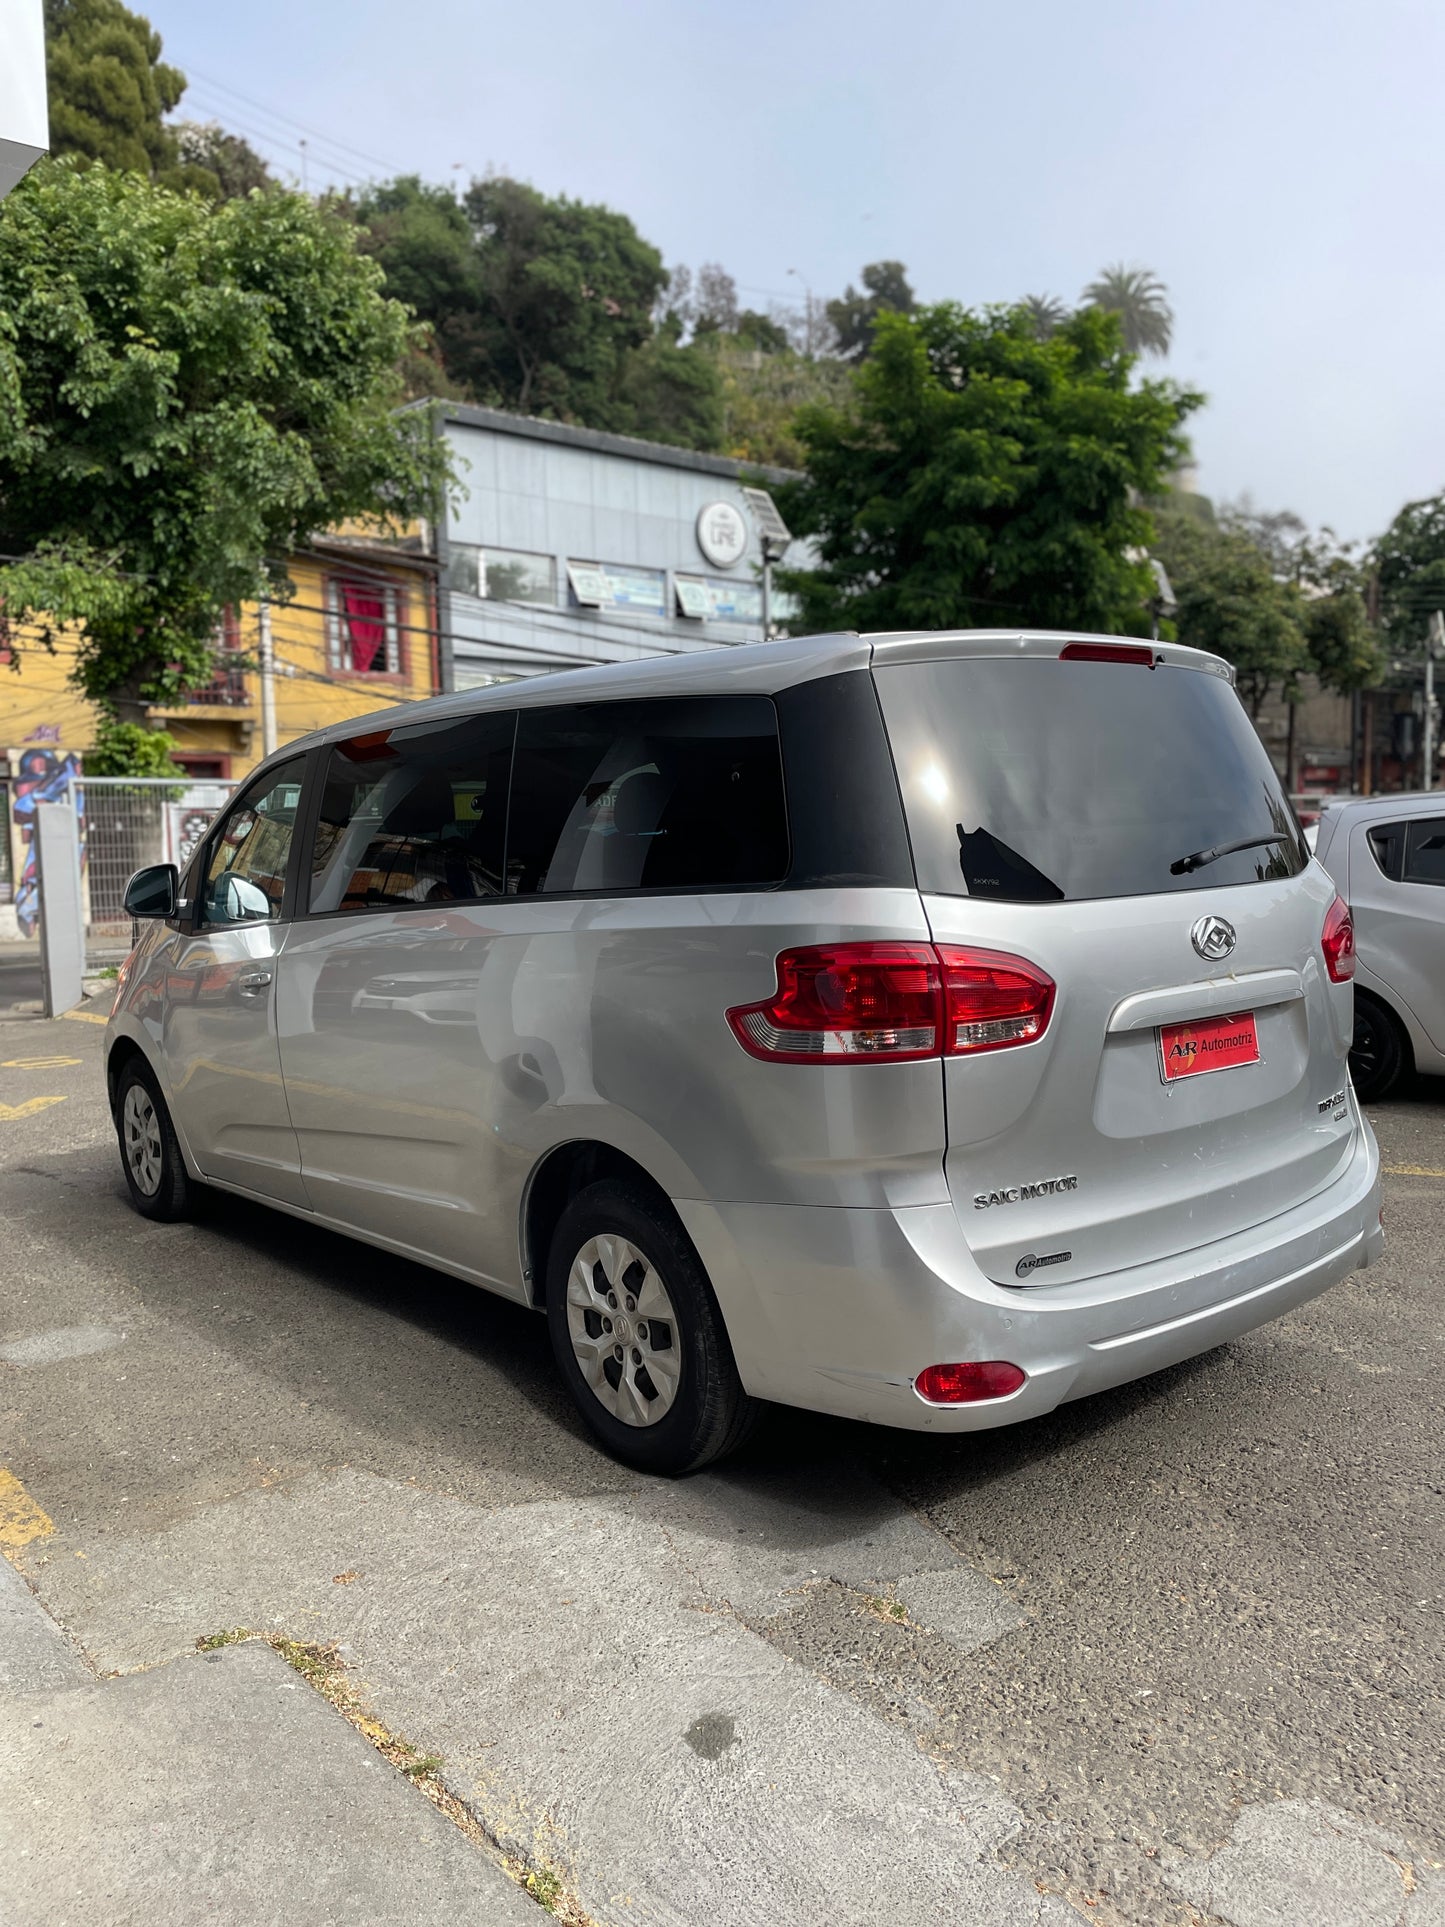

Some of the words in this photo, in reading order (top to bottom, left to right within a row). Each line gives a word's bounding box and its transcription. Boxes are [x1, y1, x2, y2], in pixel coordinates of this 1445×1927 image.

[1200, 1031, 1253, 1053] Automotriz
[973, 1187, 1019, 1210] SAIC
[1020, 1174, 1078, 1201] MOTOR
[1018, 1260, 1036, 1270] AR
[1037, 1253, 1071, 1268] Automotriz
